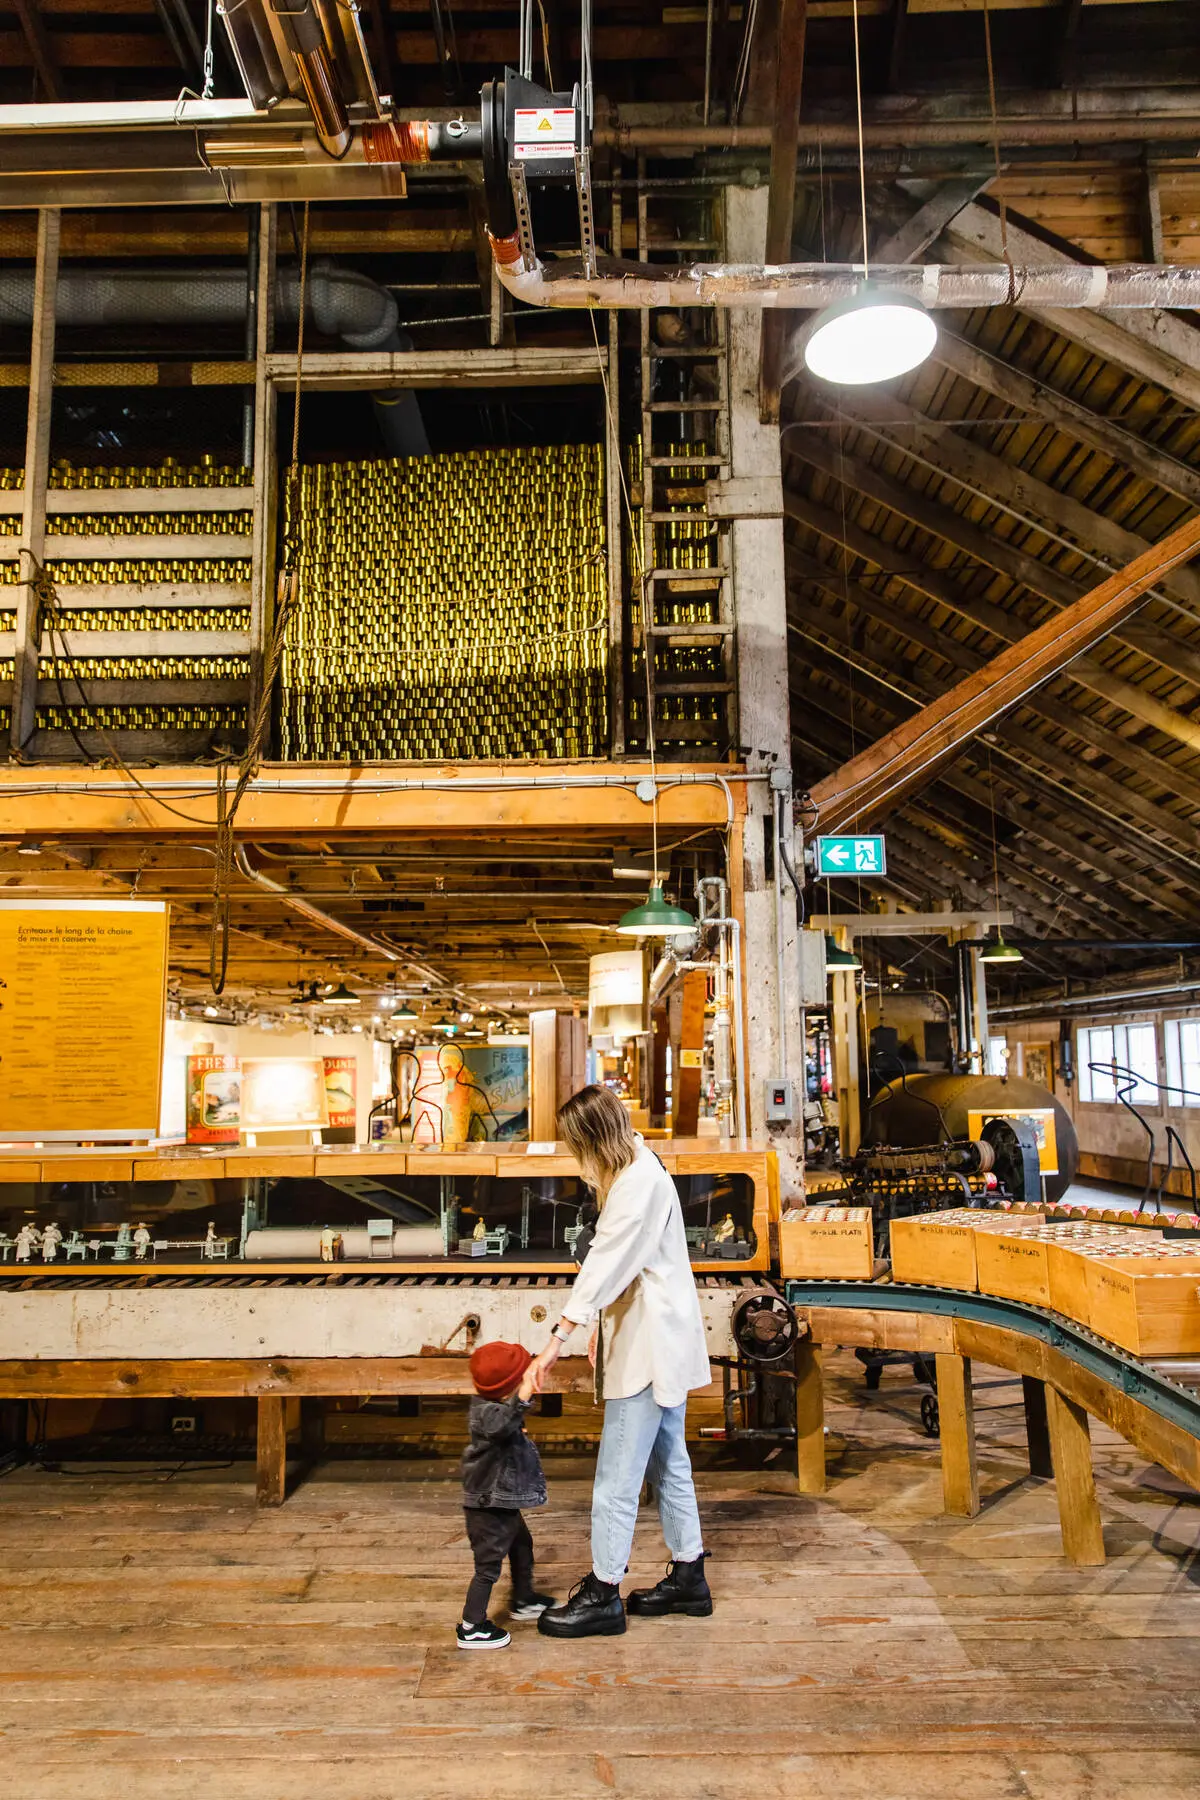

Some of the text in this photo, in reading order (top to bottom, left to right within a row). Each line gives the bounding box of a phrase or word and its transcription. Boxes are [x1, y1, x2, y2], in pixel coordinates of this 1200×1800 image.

[56, 926, 62, 934] le
[65, 926, 82, 936] long
[85, 927, 95, 935] de
[97, 927, 105, 935] la
